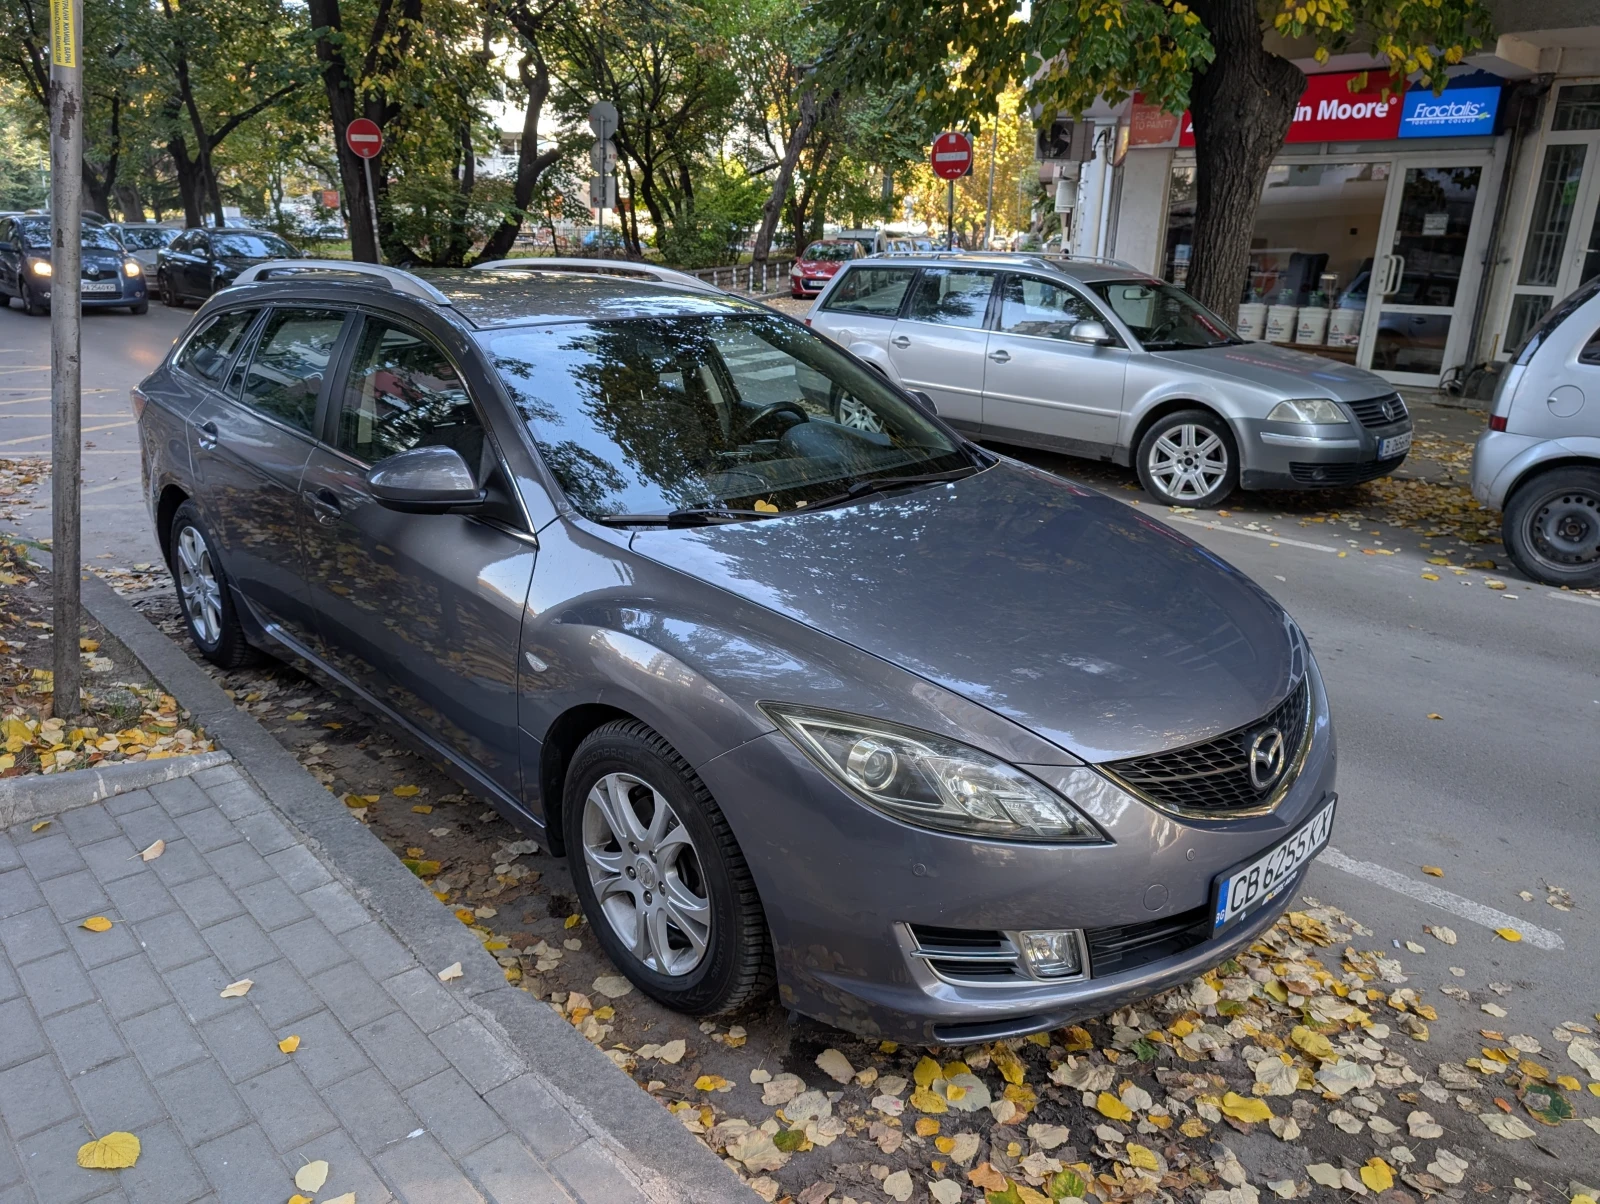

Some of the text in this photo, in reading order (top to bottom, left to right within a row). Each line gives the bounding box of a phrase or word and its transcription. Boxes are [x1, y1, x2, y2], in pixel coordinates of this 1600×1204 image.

[1413, 101, 1480, 118] Fractalis
[1135, 119, 1173, 130] TO PAINT?
[1215, 909, 1225, 924] BG
